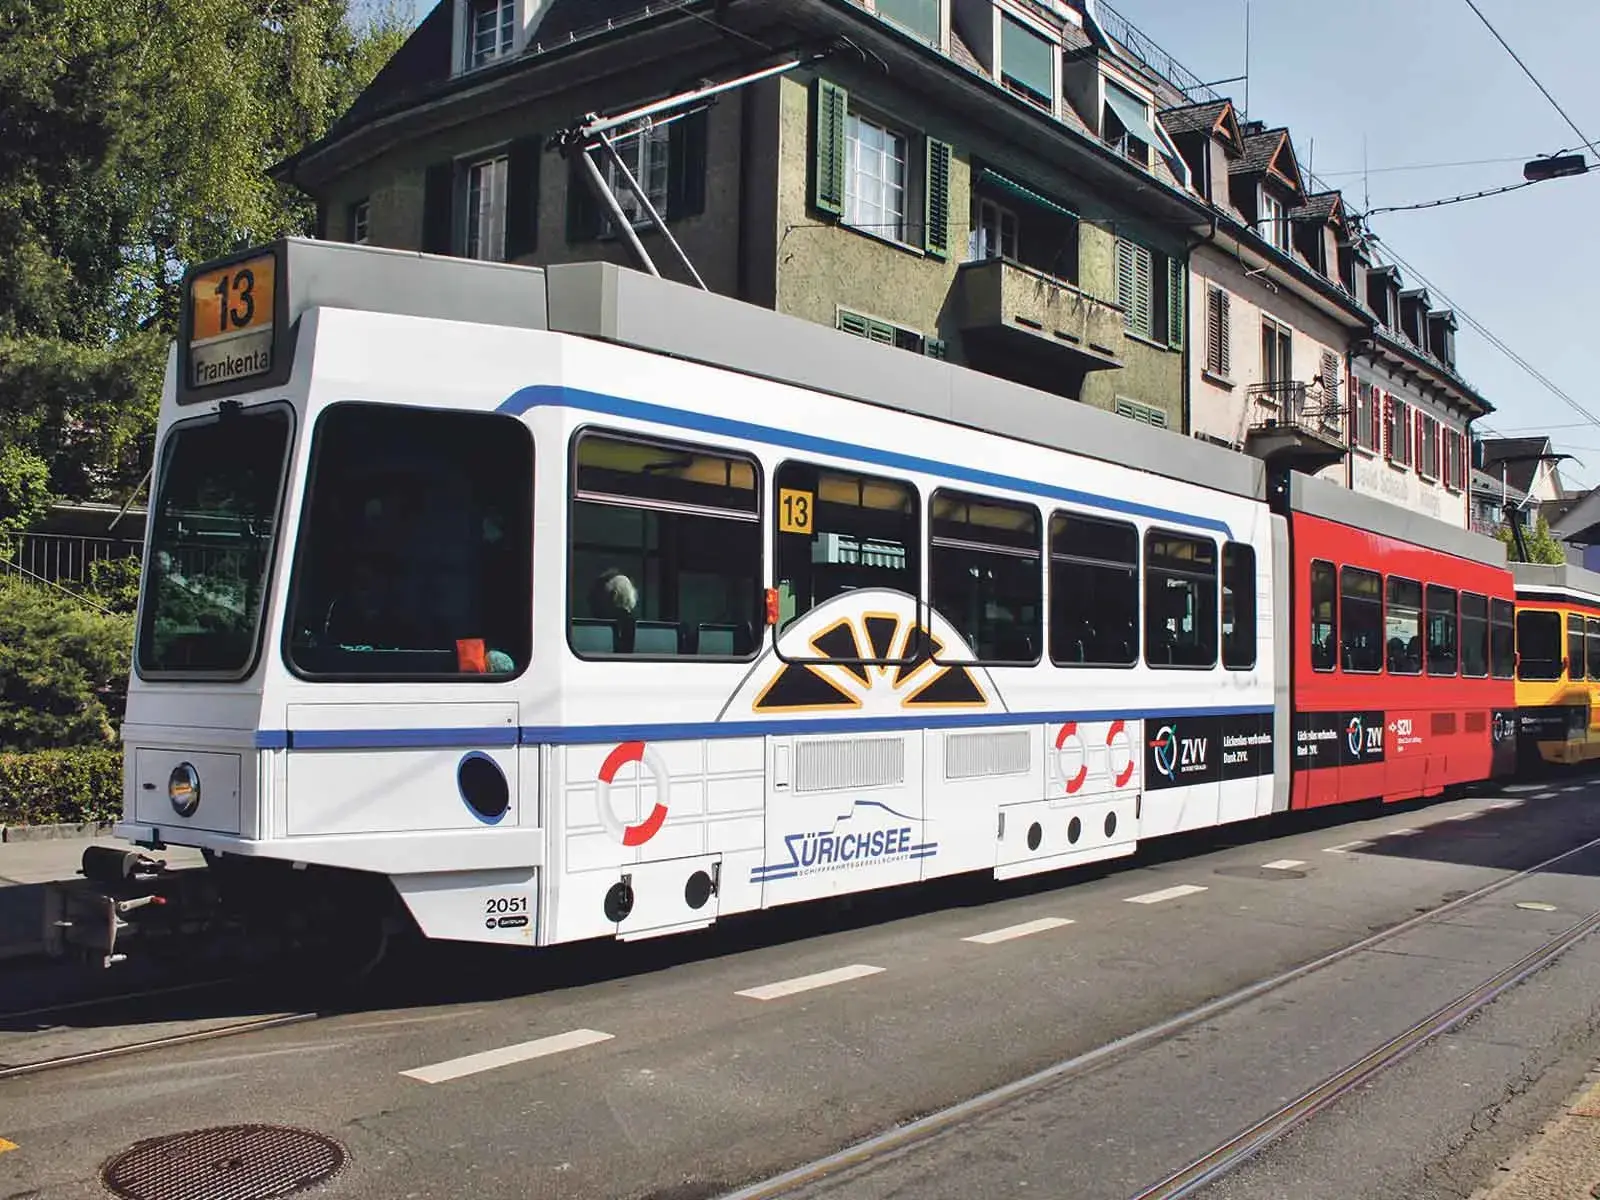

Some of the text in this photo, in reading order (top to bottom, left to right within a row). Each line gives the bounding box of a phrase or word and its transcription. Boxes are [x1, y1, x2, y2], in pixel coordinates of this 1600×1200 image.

[215, 269, 254, 331] 13
[196, 349, 269, 382] Frankenta
[784, 495, 808, 528] 13
[1181, 738, 1207, 764] ZVV
[1366, 727, 1383, 747] ZVV
[784, 827, 912, 867] ZÜRICHSEE
[486, 897, 527, 913] 2051
